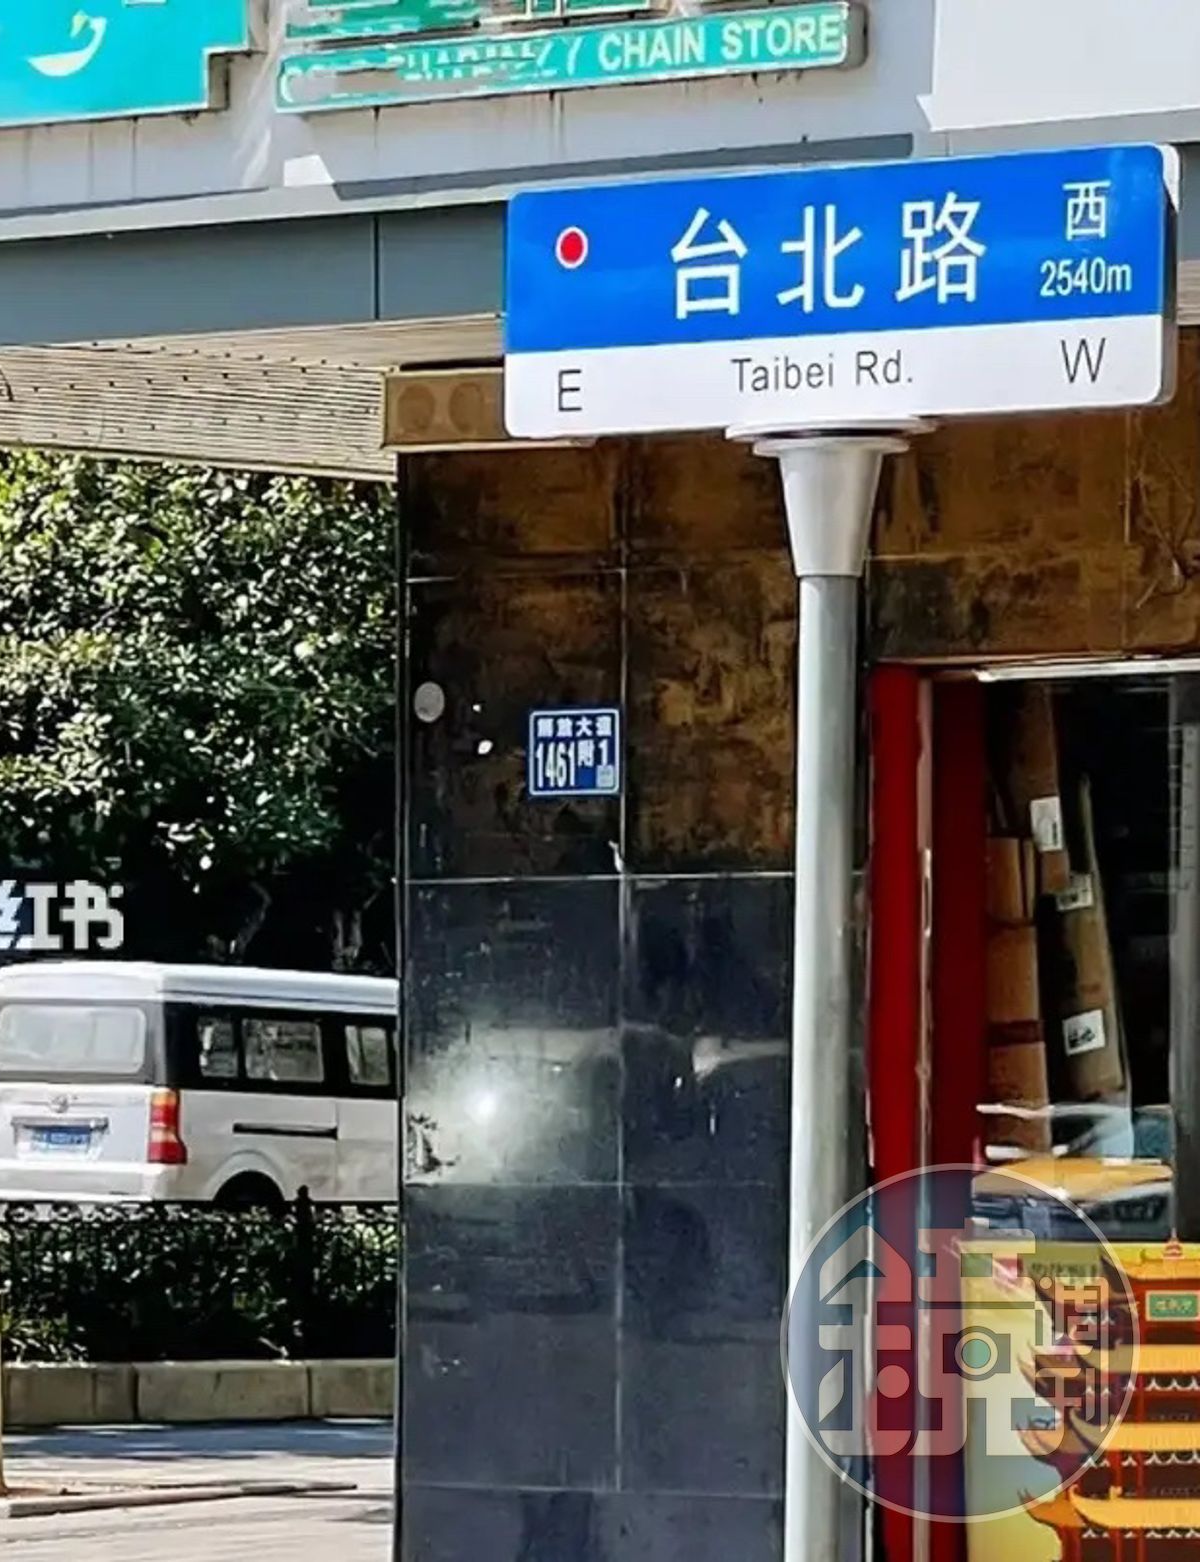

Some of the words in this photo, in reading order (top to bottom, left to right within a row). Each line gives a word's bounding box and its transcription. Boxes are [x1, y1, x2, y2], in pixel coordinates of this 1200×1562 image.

[598, 25, 704, 71] CHAIN
[721, 14, 841, 60] STORE
[1063, 180, 1111, 240] 西
[669, 191, 986, 320] 台北路
[1040, 259, 1132, 298] 2540m
[731, 353, 835, 394] Taibei
[855, 348, 914, 388] Rd.
[1061, 337, 1106, 384] W
[557, 369, 583, 412] E
